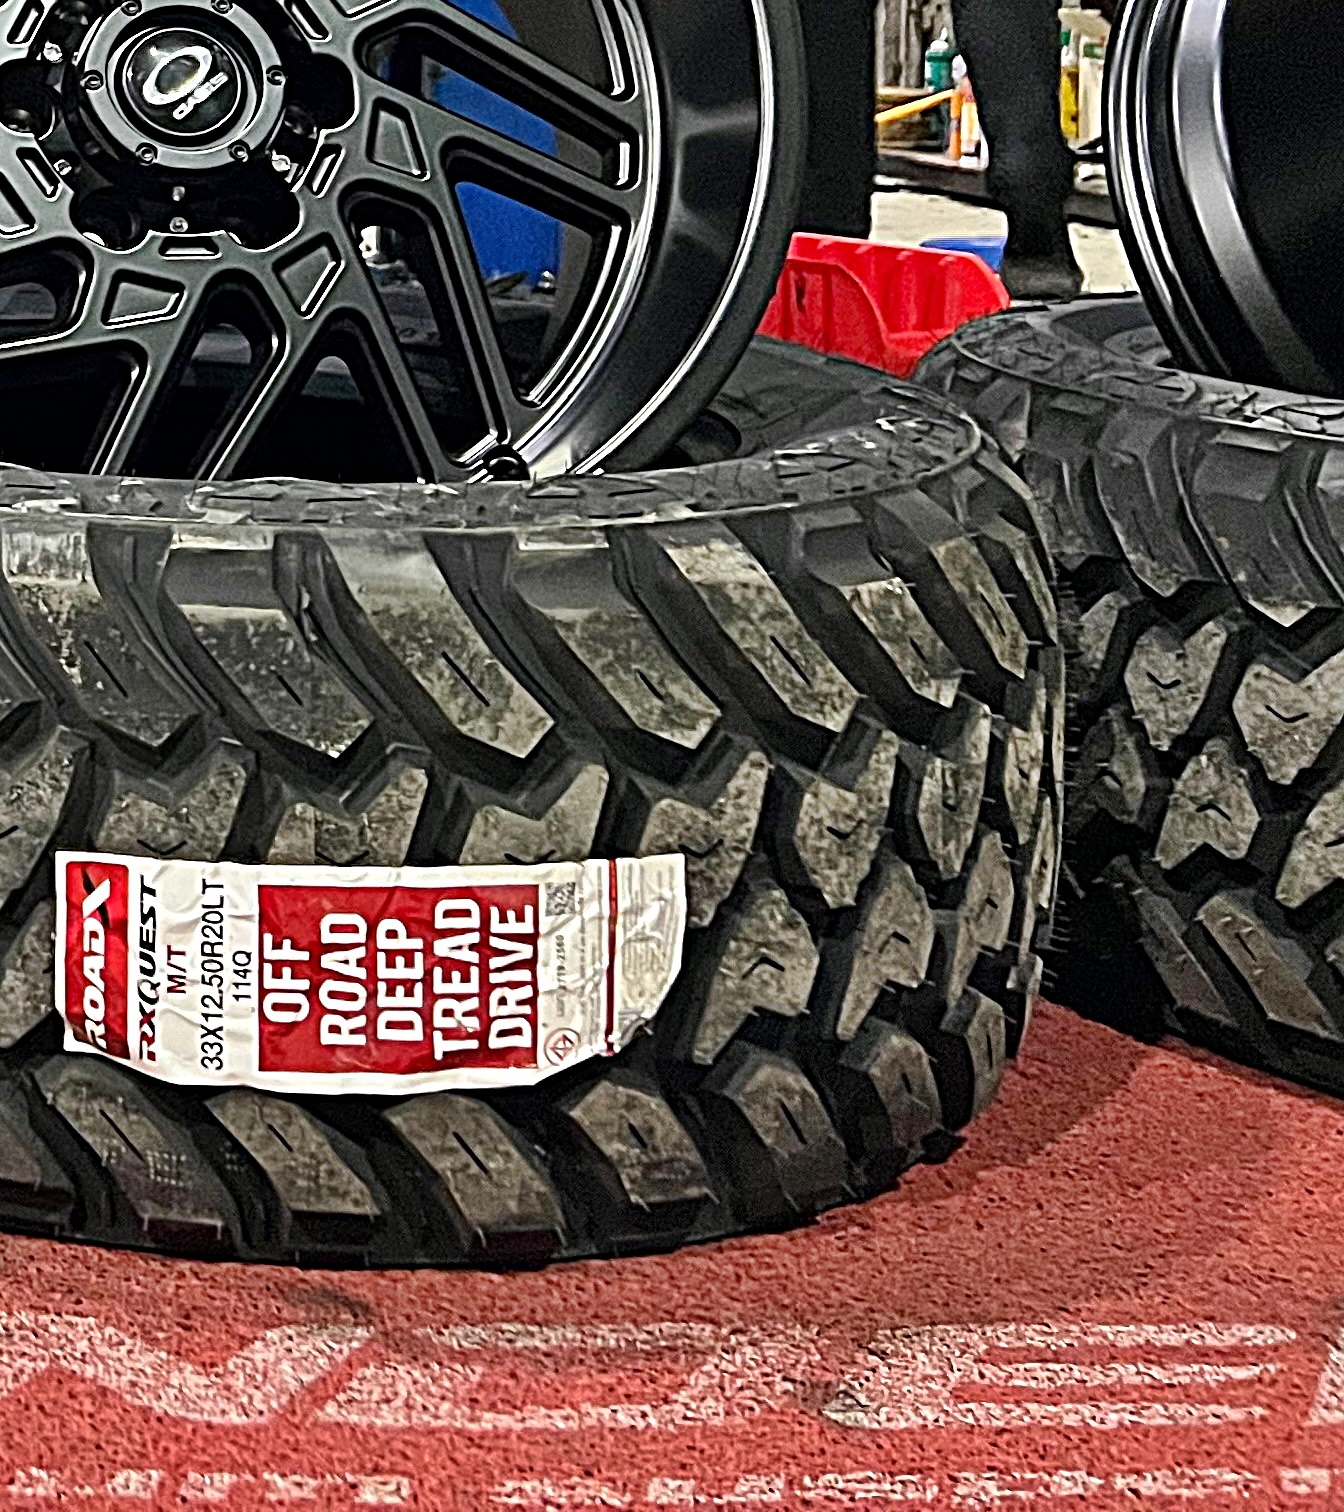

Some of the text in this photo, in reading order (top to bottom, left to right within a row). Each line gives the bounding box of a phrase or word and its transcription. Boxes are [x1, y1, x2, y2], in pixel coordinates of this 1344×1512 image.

[81, 866, 111, 1049] ROADX
[137, 874, 161, 1062] RXQUEST
[167, 944, 187, 994] M/T
[201, 878, 224, 1070] 33X12.50R20LT
[232, 950, 252, 1001] 114Q
[262, 932, 311, 1024] OFF
[319, 912, 368, 1046] ROAD
[376, 918, 424, 1043] DEEP
[432, 898, 481, 1060] TREAD
[487, 904, 535, 1050] DRIVE
